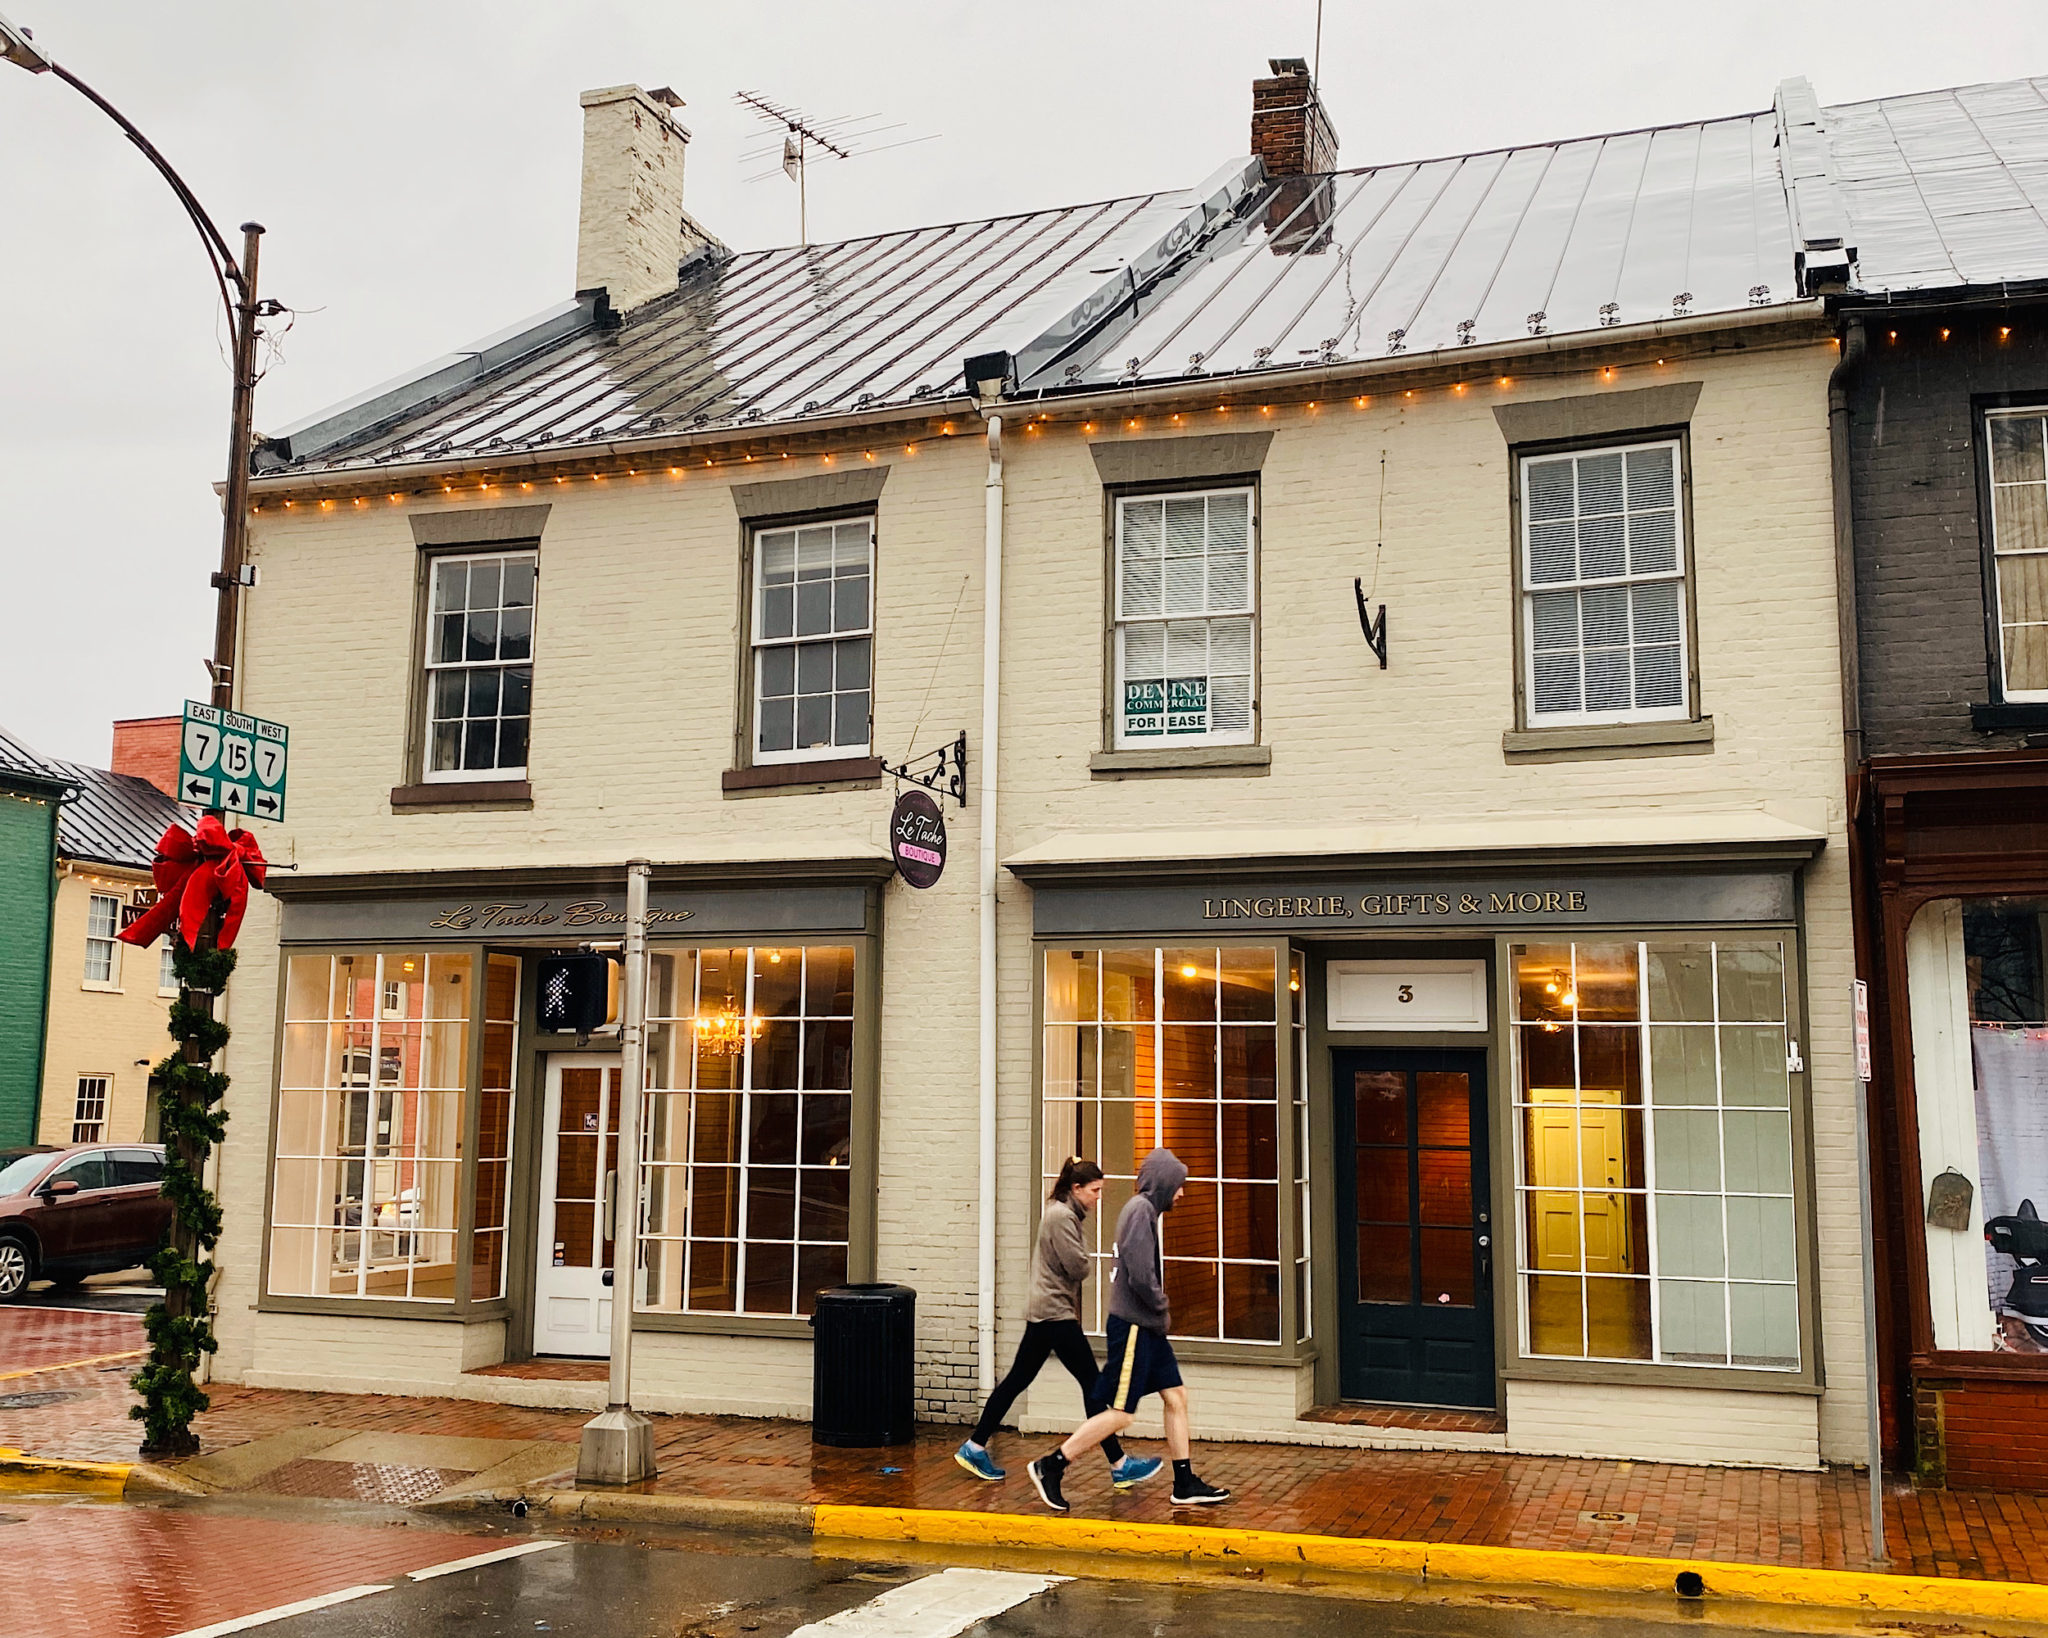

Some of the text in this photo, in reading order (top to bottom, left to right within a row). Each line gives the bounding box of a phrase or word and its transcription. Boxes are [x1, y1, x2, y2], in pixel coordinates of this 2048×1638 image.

[193, 705, 282, 738] EAST SOUTH WEST
[1129, 718, 1156, 728] FOR
[196, 733, 276, 777] 7 15 7
[896, 811, 945, 845] Le Tache
[905, 846, 935, 863] BOUTIQUE
[429, 900, 696, 930] Le Tache Bouque
[1203, 891, 1587, 918] LINGERIE, GIFTS & MORE
[1398, 985, 1413, 1003] 3
